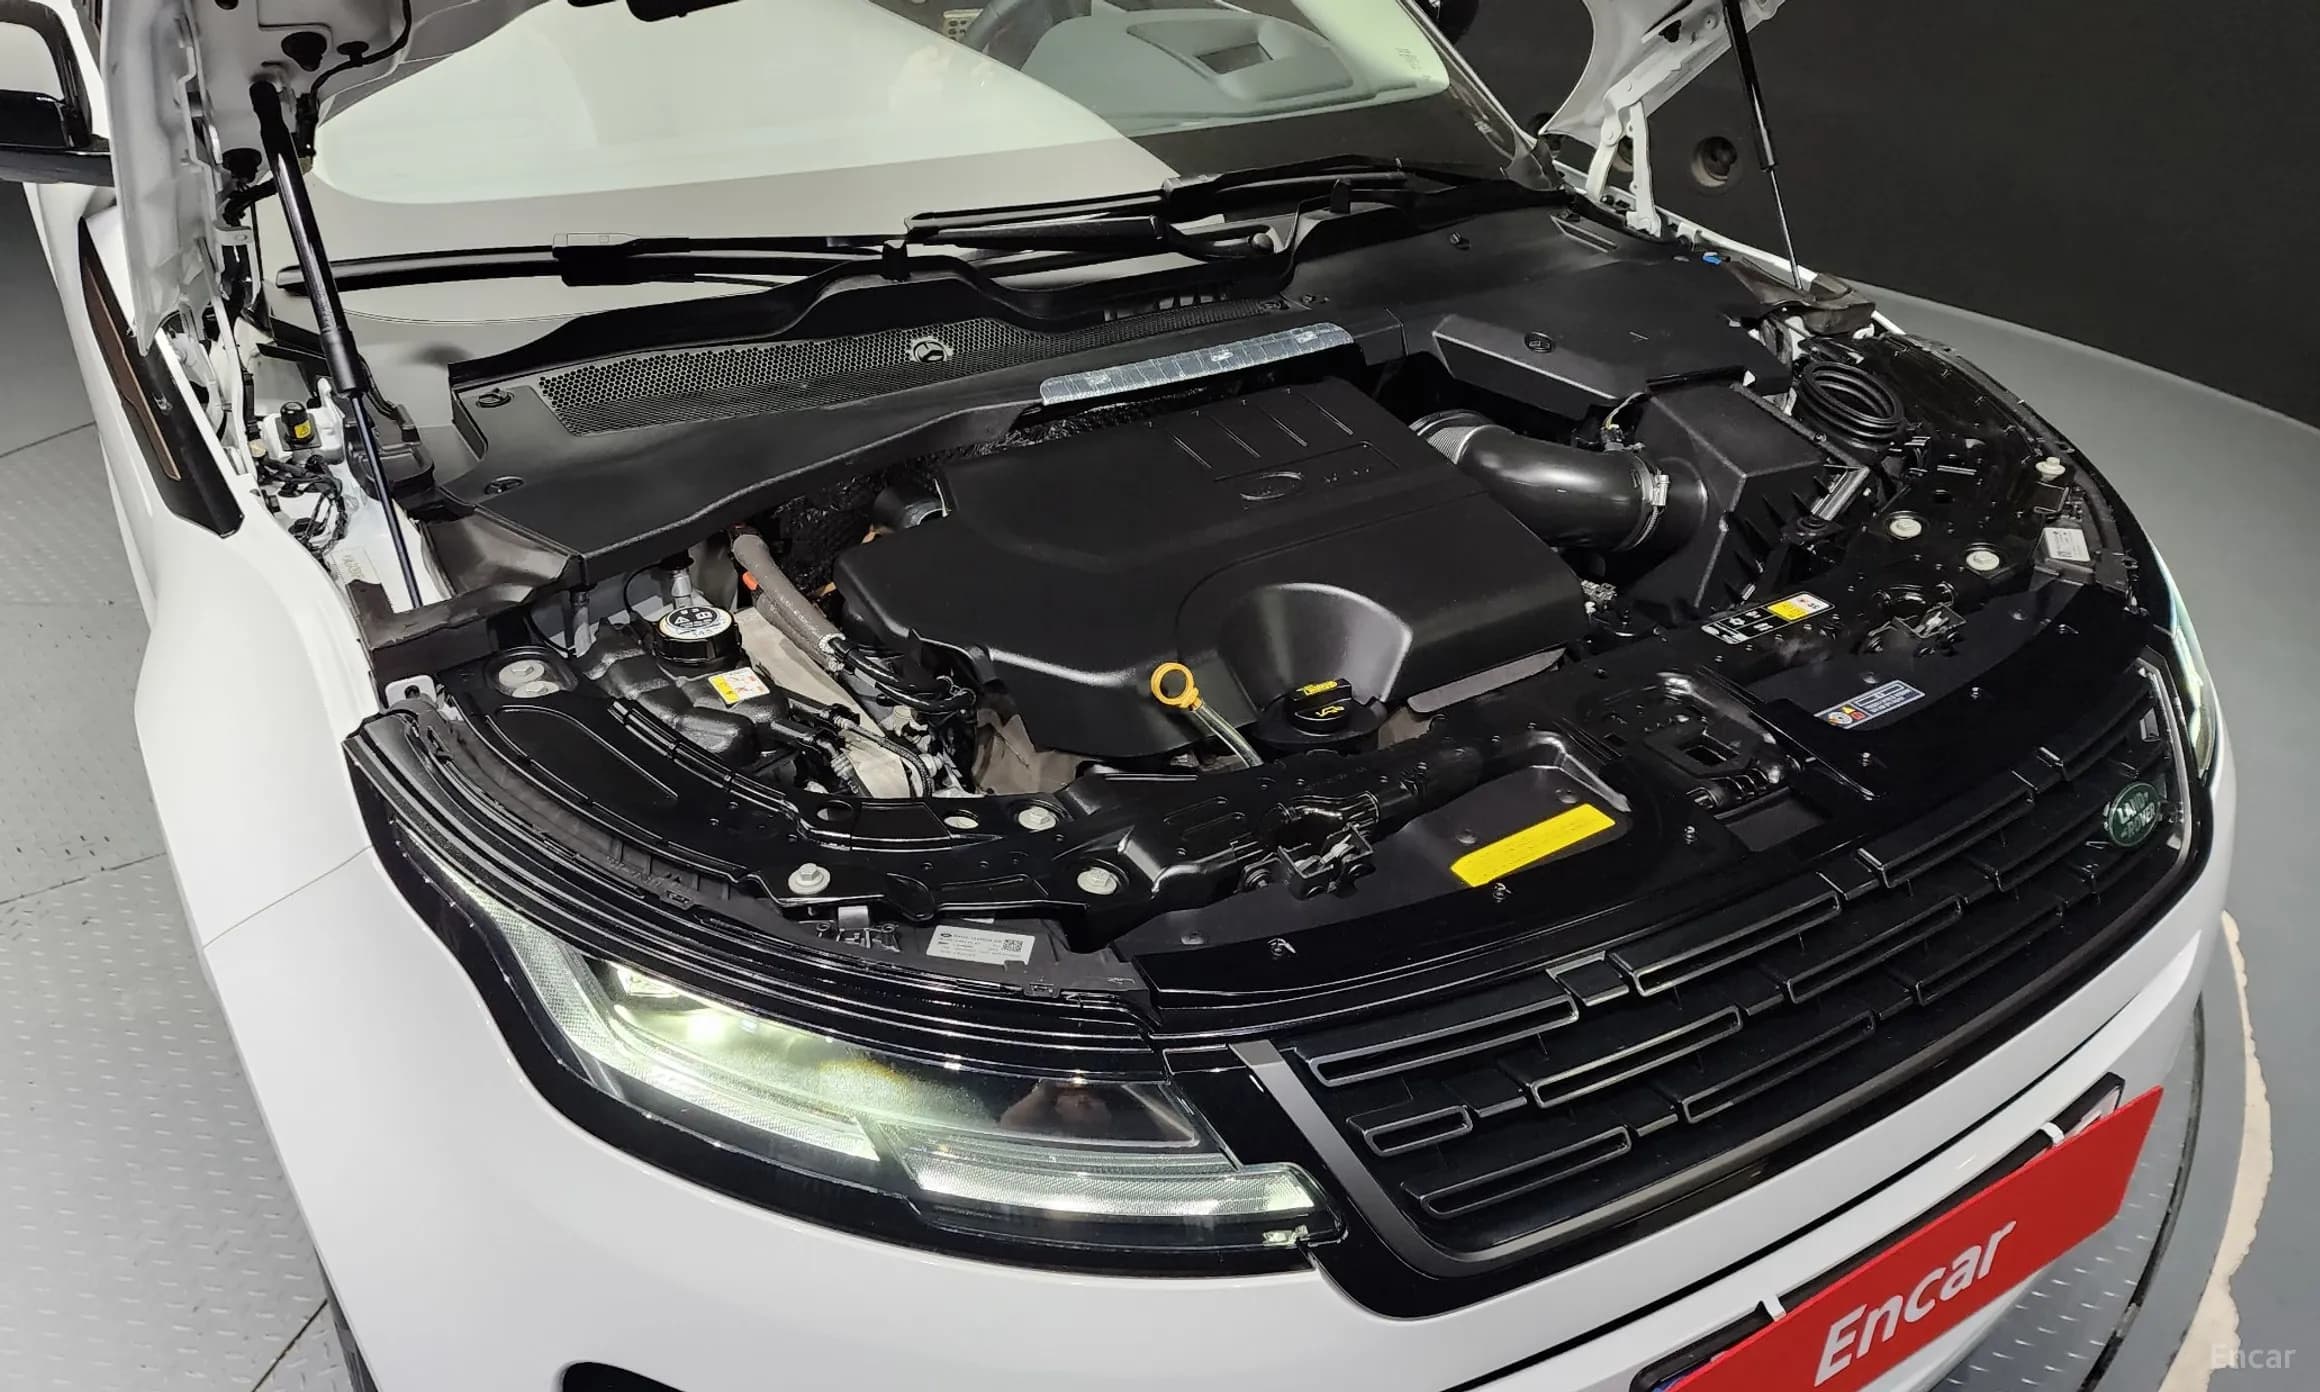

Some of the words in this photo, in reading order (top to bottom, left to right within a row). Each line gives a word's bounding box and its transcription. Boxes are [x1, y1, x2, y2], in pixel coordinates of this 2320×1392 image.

[2117, 792, 2146, 825] LAND
[2127, 802, 2156, 839] ROVER
[1814, 1220, 2017, 1387] Encar
